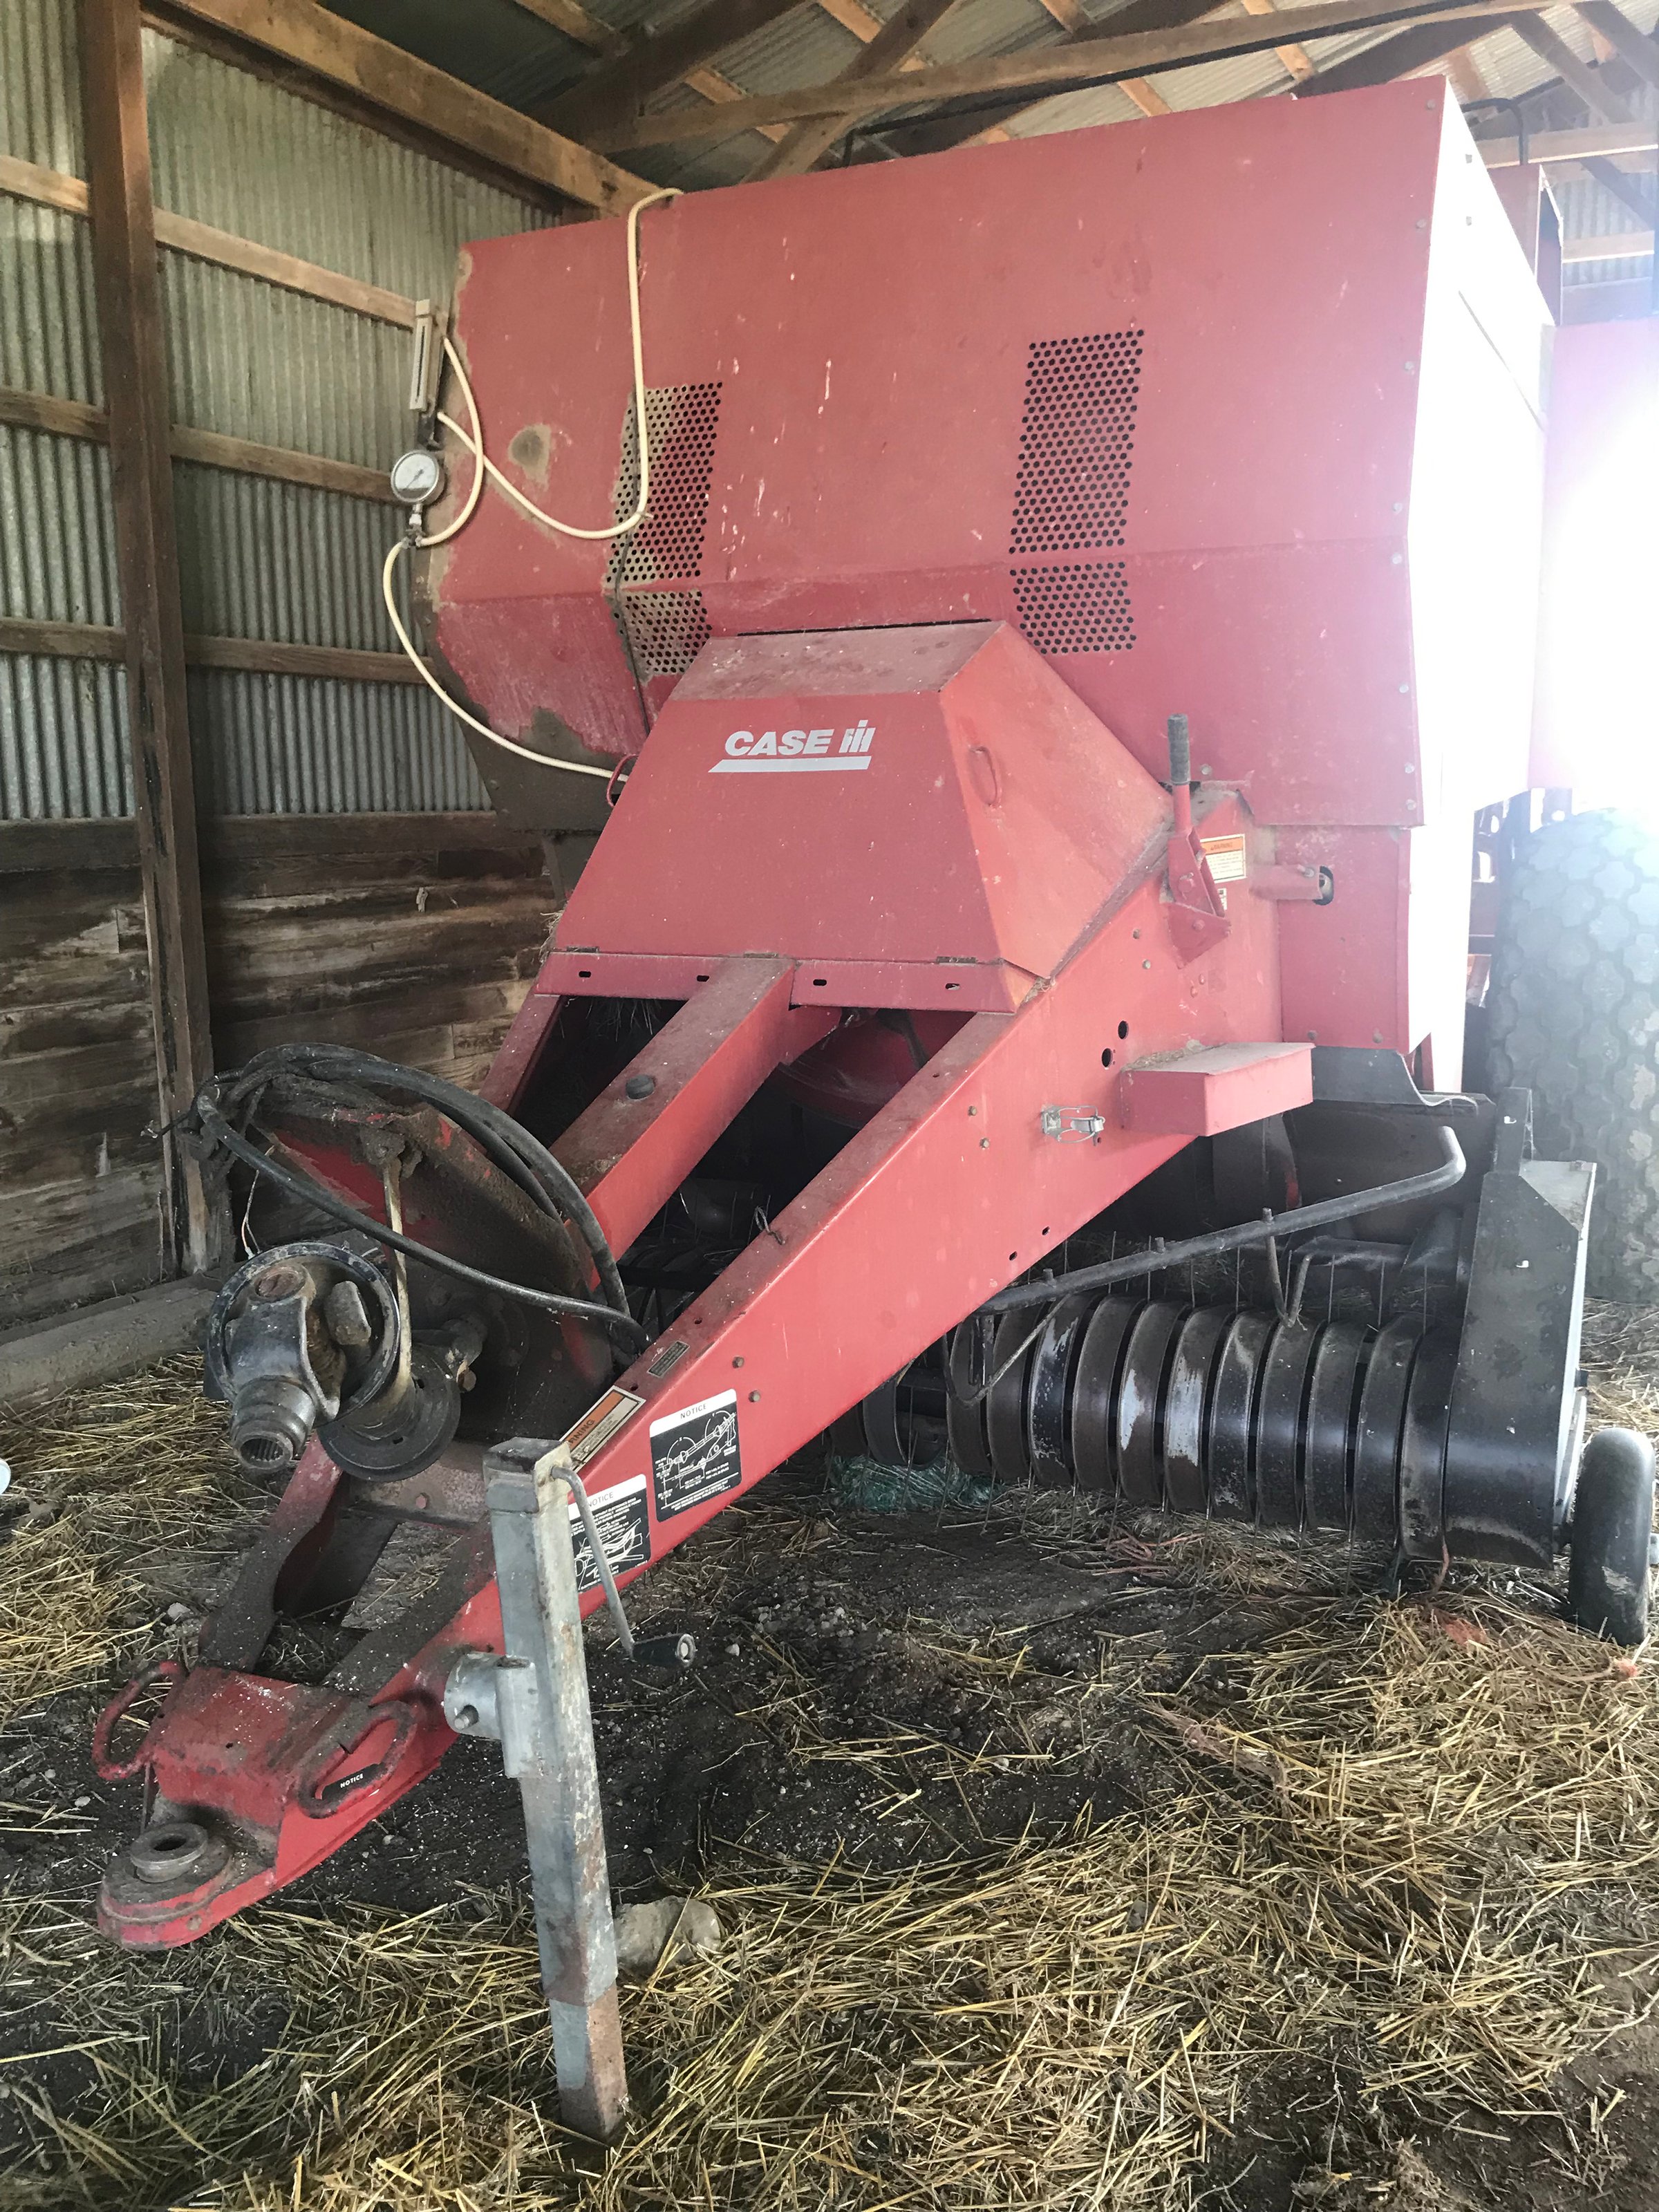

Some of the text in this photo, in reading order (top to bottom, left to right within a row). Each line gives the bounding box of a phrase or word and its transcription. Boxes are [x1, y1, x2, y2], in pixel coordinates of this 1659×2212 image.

[724, 729, 835, 756] CASE
[680, 1403, 706, 1419] NOTICE
[568, 1419, 594, 1444] RNING
[340, 1773, 364, 1788] NOTICE
